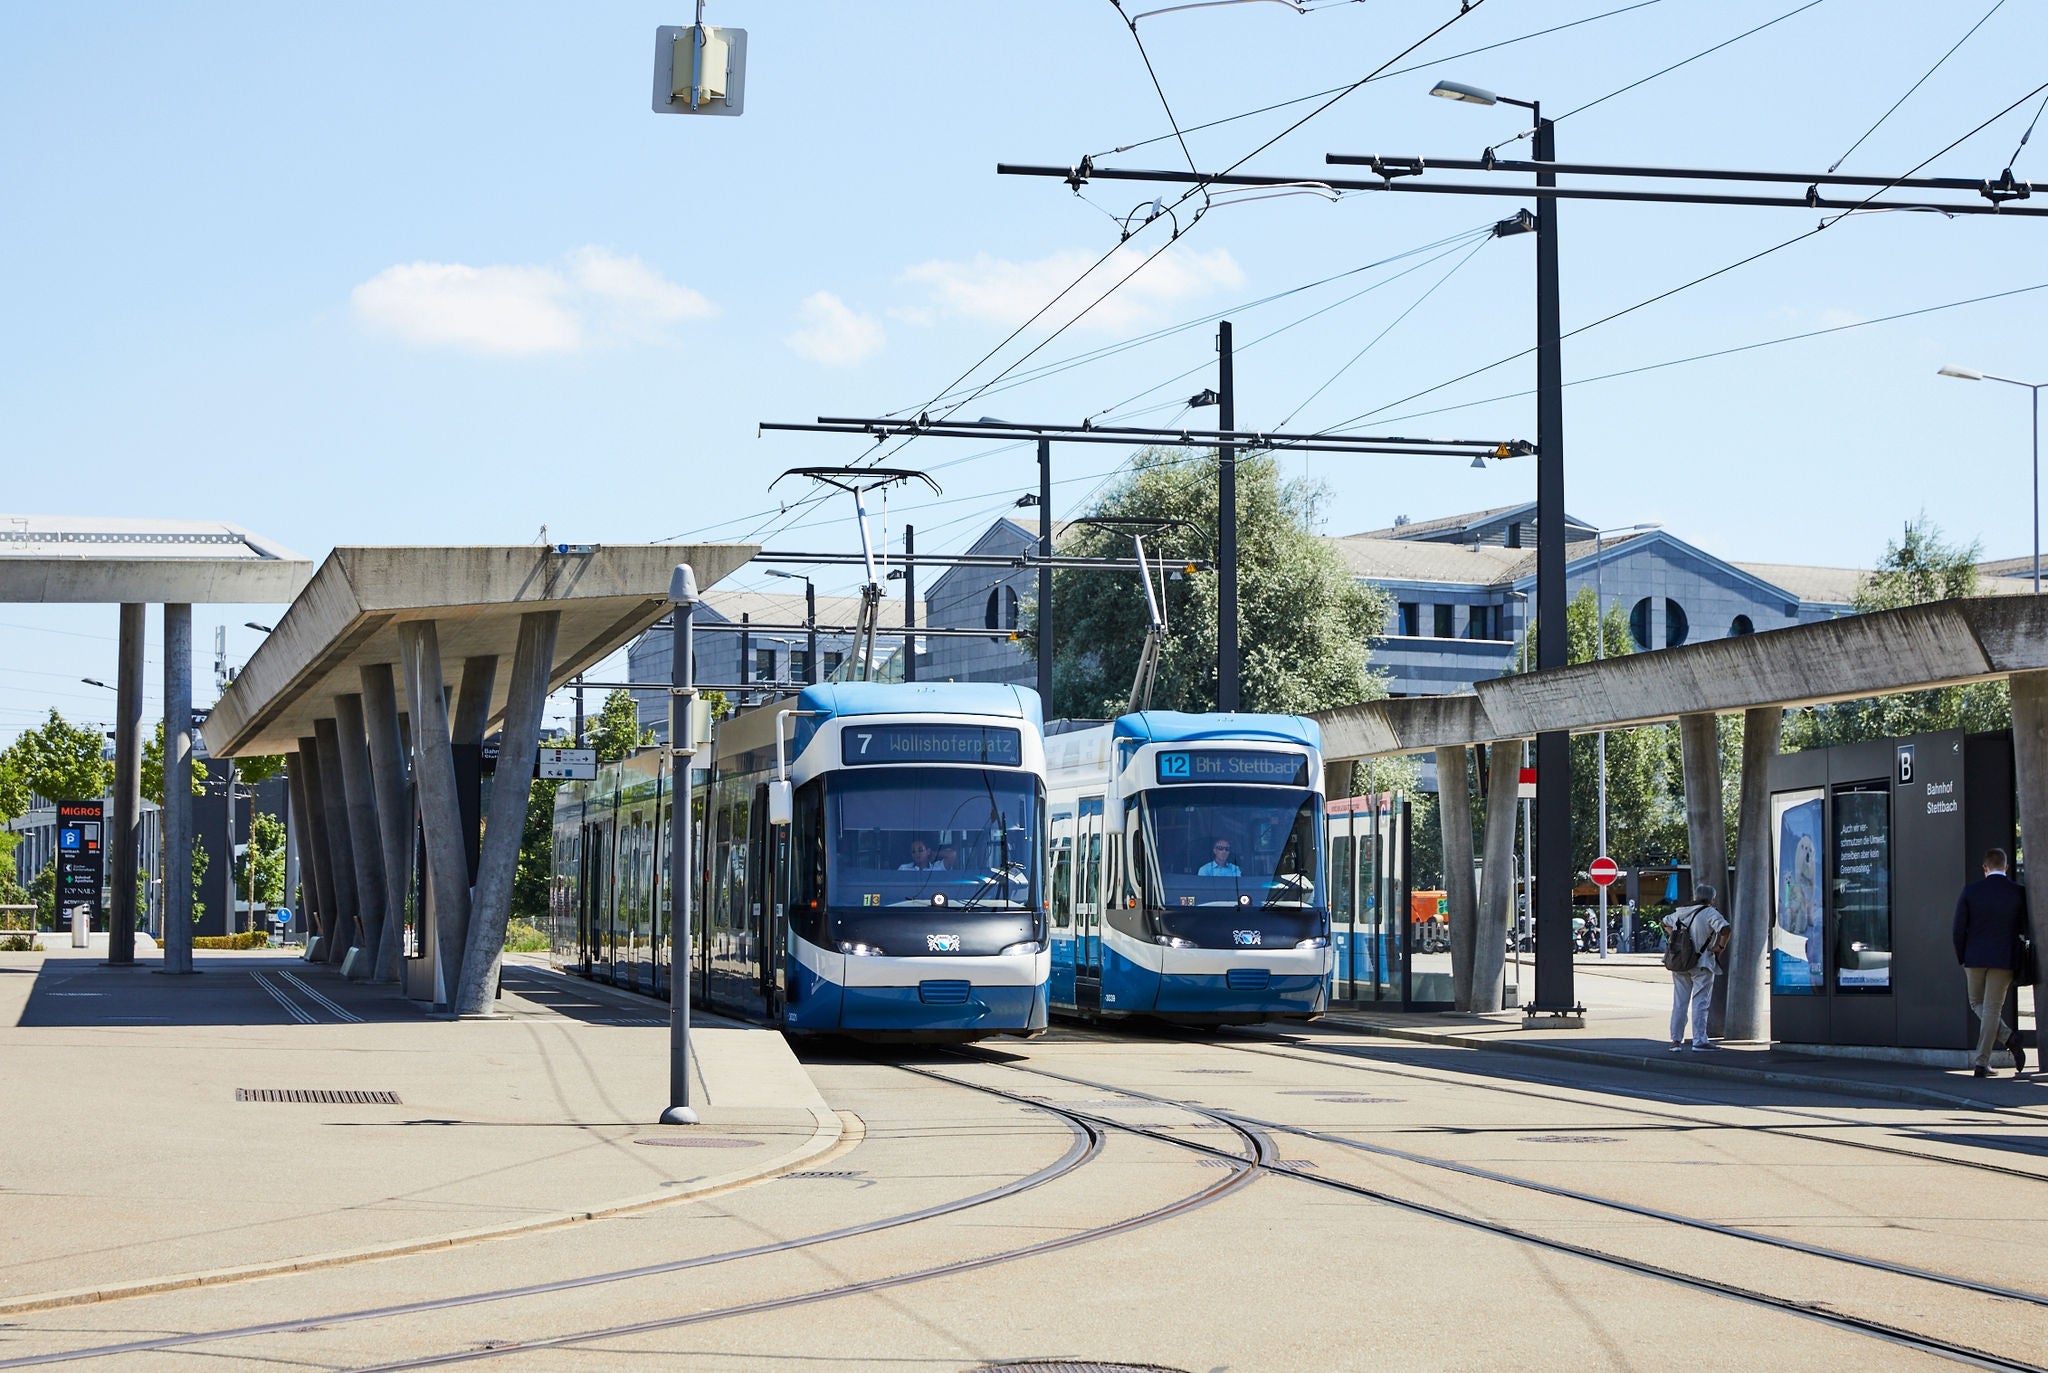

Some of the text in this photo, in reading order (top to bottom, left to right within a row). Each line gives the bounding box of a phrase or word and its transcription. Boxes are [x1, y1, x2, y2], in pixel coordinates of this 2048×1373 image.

[857, 733, 1012, 754] 7 Wollishoferplatz
[1164, 756, 1187, 774] 12
[1229, 757, 1300, 774] Stettbach
[1901, 752, 1911, 780] B
[1926, 781, 1953, 795] Bahnhof
[61, 807, 101, 816] MIGROS
[1926, 800, 1958, 814] Stettbach
[77, 887, 96, 895] NAILS
